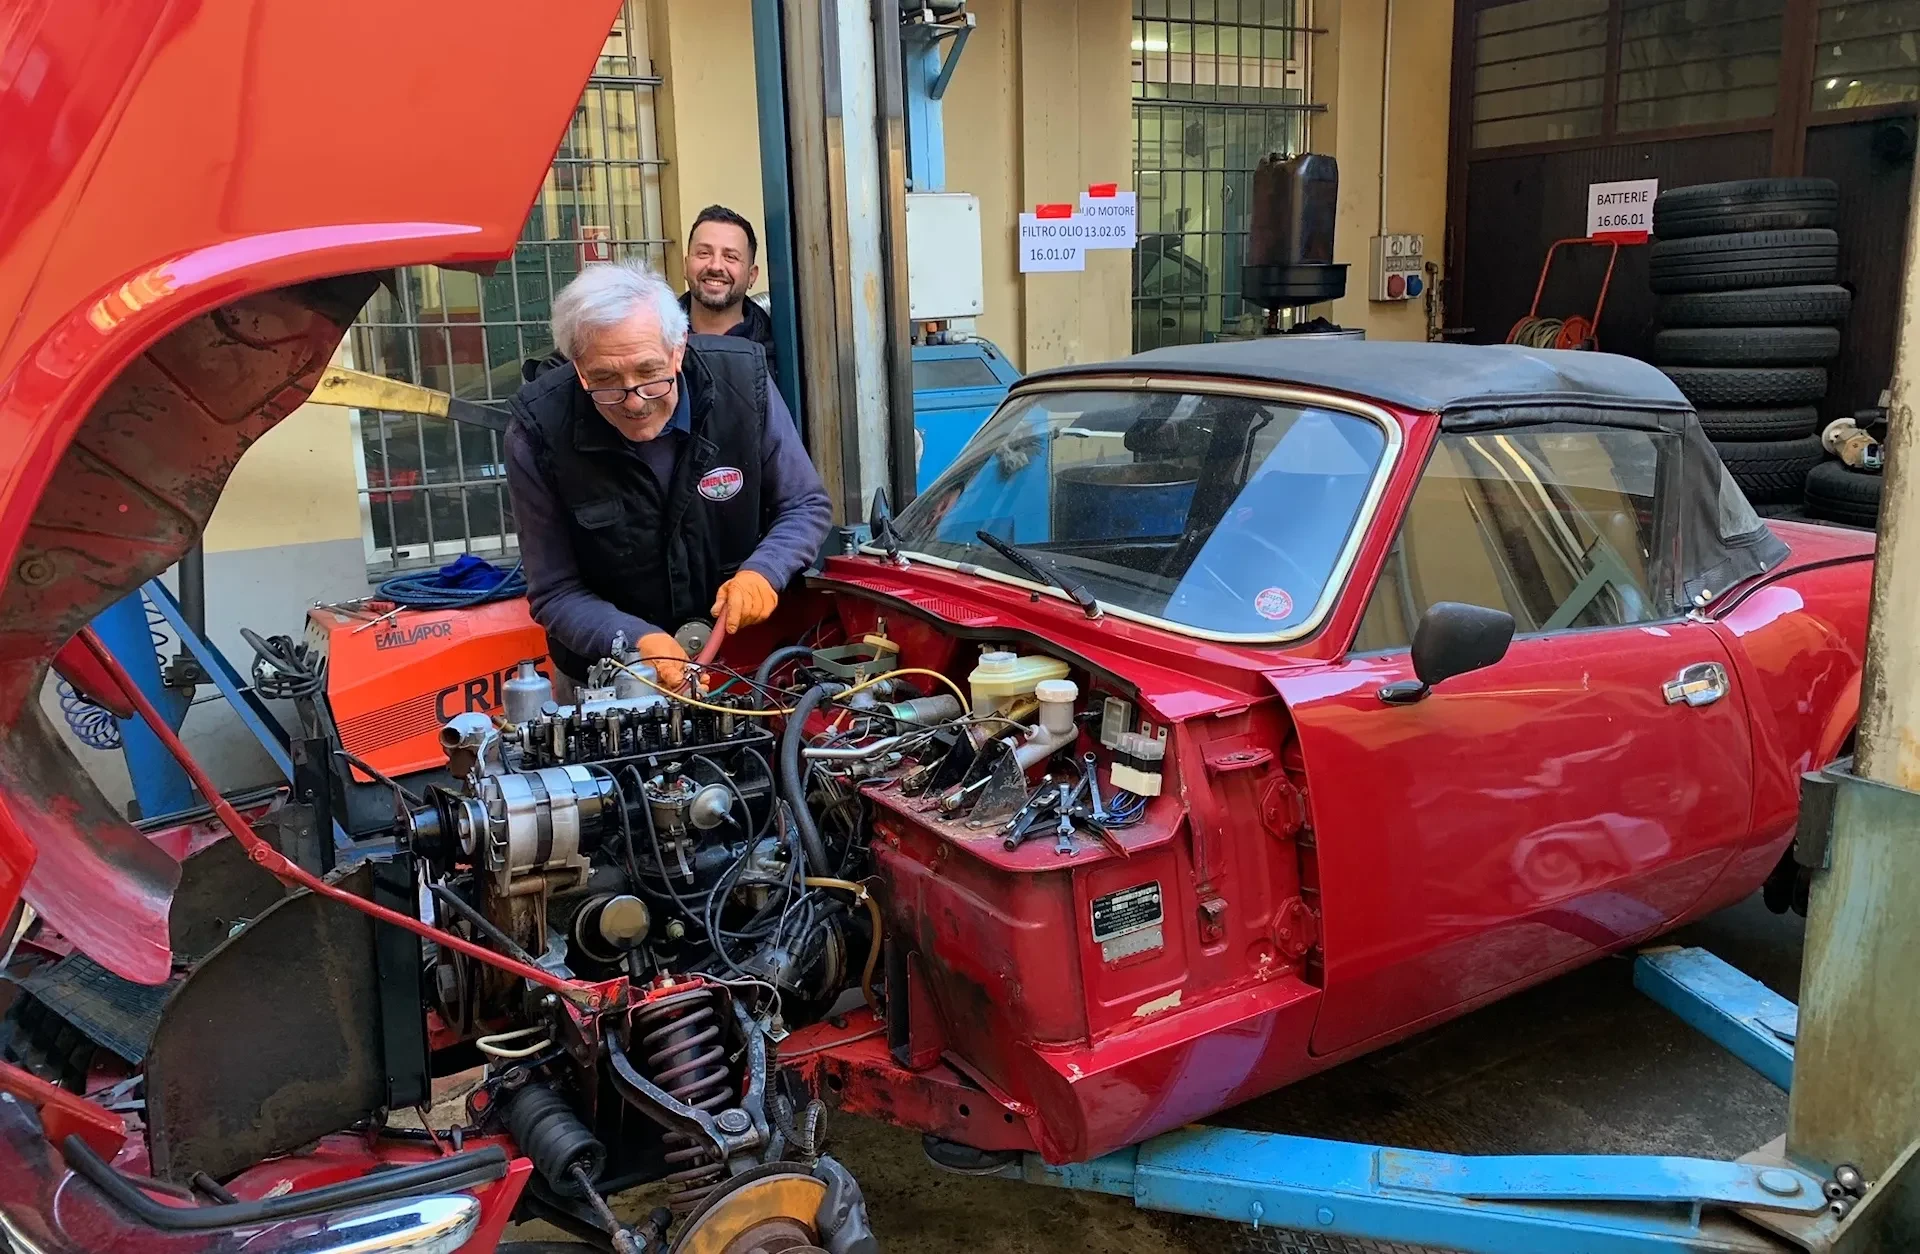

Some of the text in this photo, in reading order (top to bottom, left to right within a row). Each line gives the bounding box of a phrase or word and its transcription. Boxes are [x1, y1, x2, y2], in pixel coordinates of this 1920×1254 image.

[1597, 191, 1649, 205] BATTERIE
[1080, 206, 1135, 216] LIO MOTORE
[1597, 213, 1645, 227] 16.06.01
[1022, 225, 1083, 237] FILTRO OLIO
[1085, 225, 1126, 237] 13.02.05
[1030, 248, 1076, 260] 16.01.07
[435, 656, 551, 724] CRI
